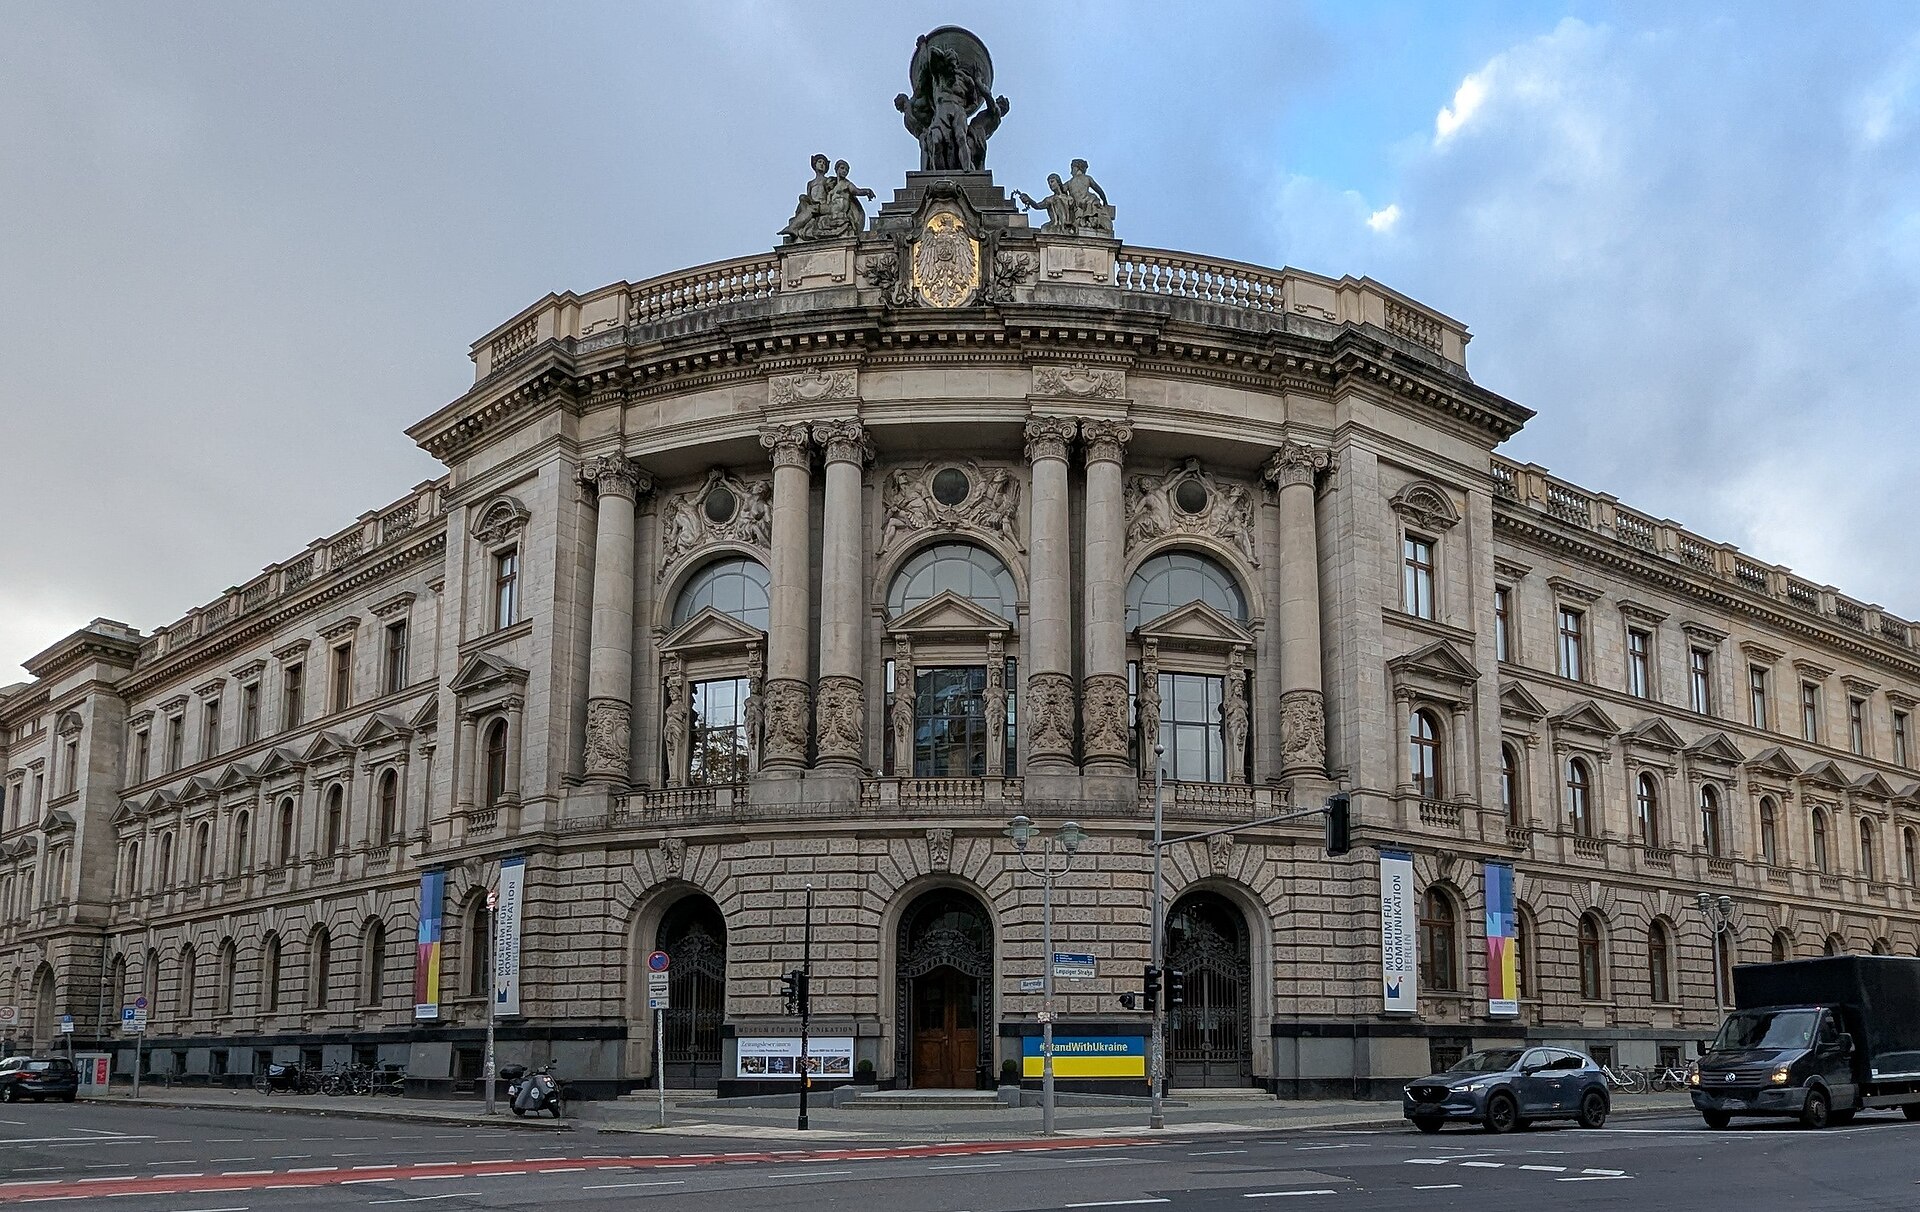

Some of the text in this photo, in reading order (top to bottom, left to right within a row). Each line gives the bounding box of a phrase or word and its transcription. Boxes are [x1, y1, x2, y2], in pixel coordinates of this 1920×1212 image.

[504, 881, 515, 976] KOMMUNIKATION
[1382, 897, 1394, 971] MUSEUM FÜR
[1393, 875, 1404, 972] KOMMUNIKATION
[498, 928, 506, 977] MUSEUM
[1056, 968, 1077, 976] Leipziger
[1404, 933, 1413, 972] BERLIN
[125, 1010, 133, 1018] P
[1039, 1041, 1128, 1052] #tandWithUkraine
